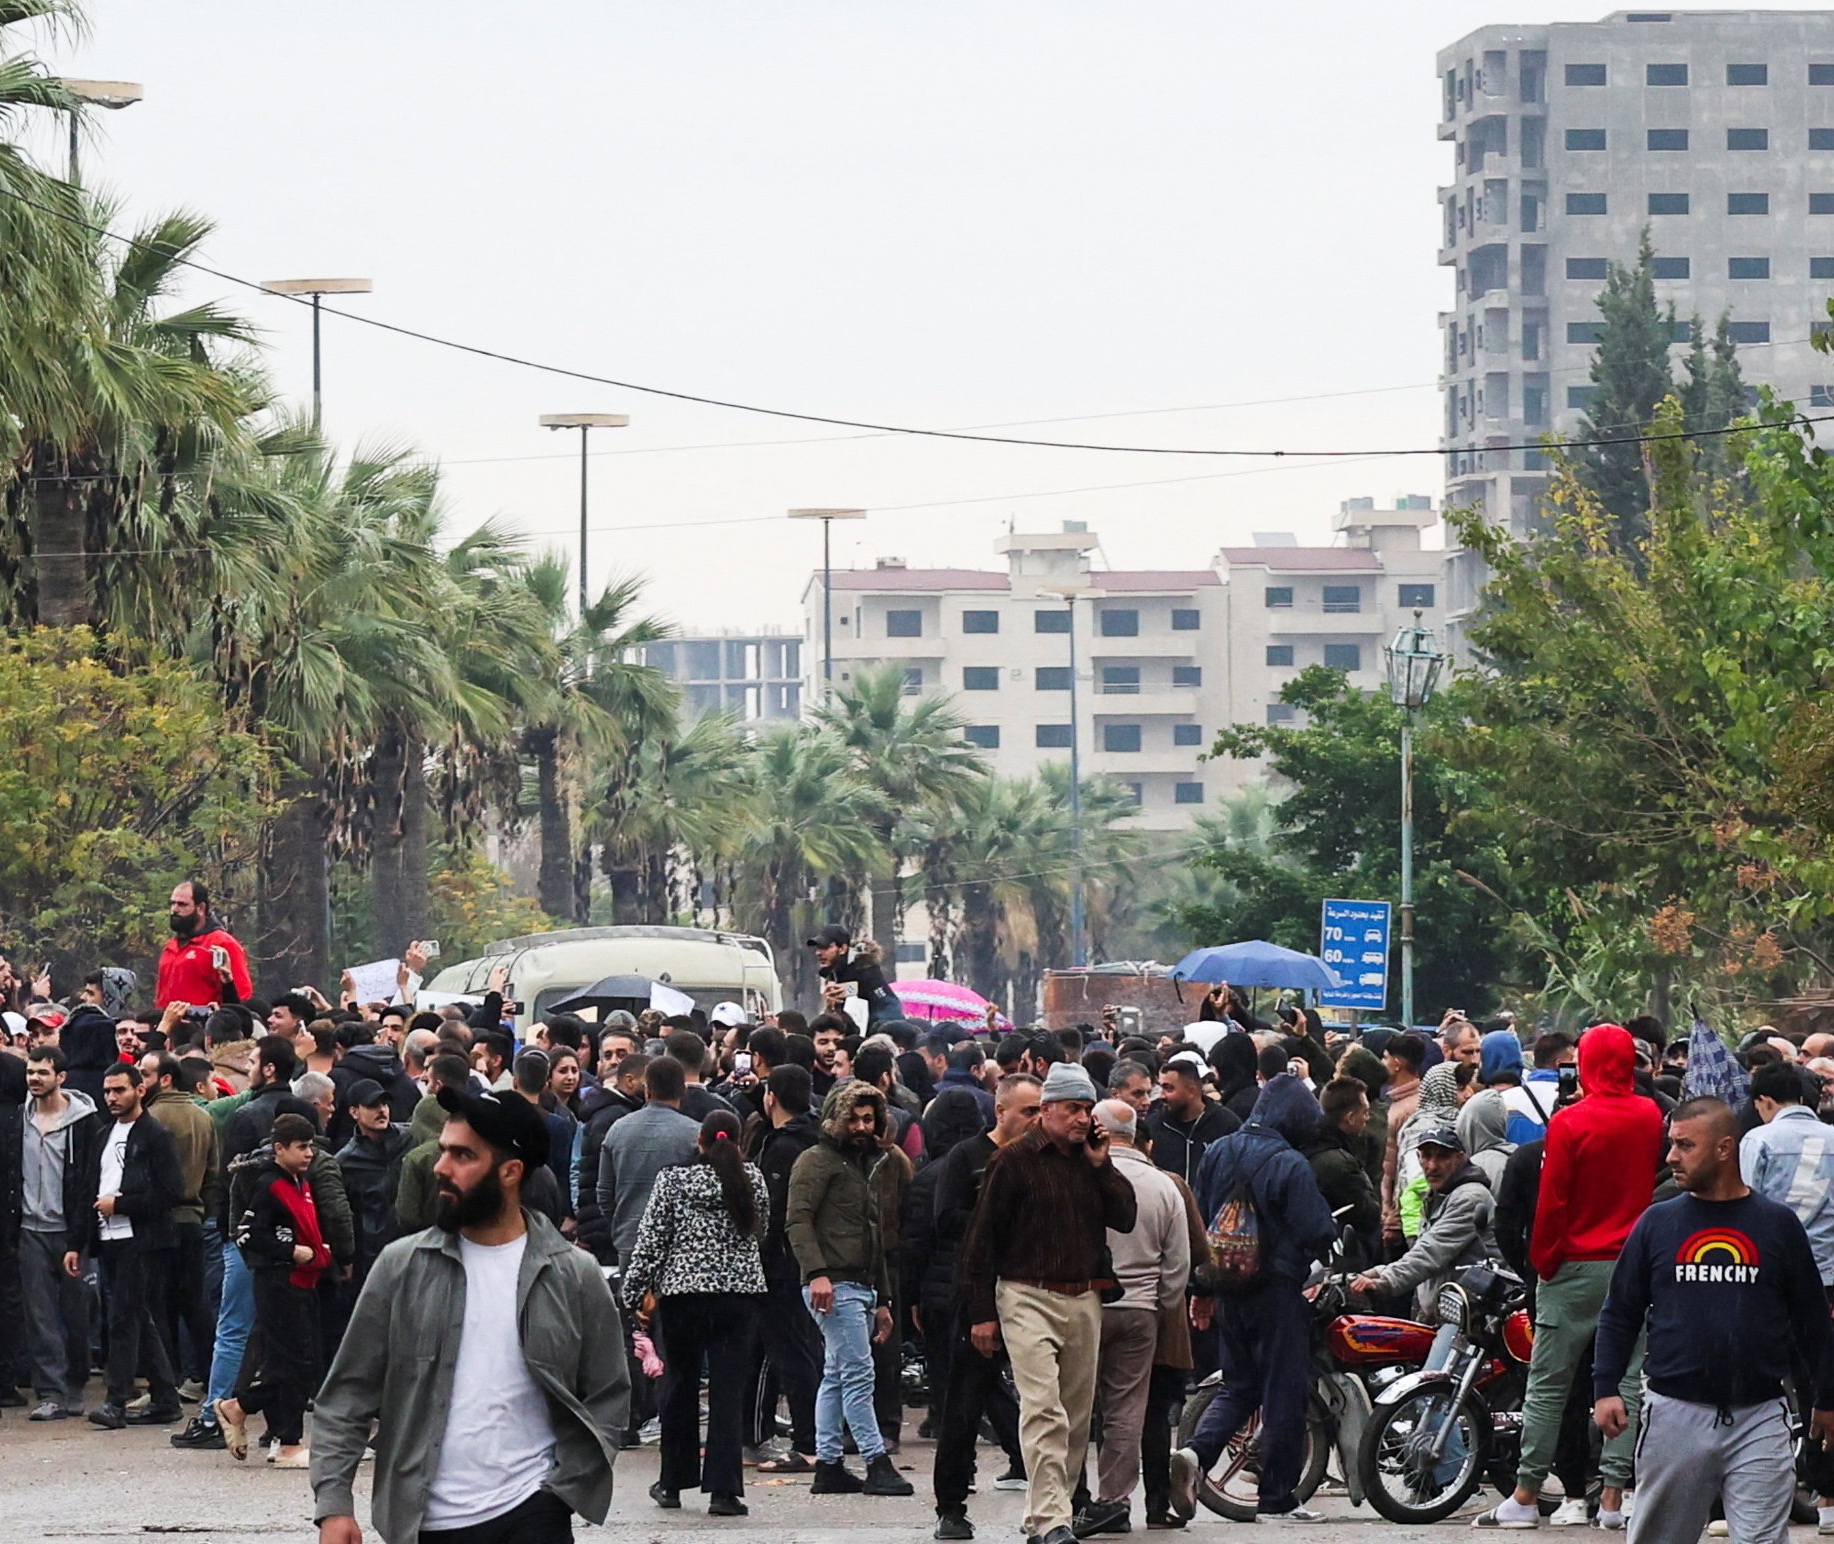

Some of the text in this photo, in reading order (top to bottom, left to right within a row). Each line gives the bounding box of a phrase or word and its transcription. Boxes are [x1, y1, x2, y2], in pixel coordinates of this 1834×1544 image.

[1325, 927, 1343, 940] 70
[1325, 950, 1342, 963] 60
[1675, 1264, 1760, 1284] FRENCHY
